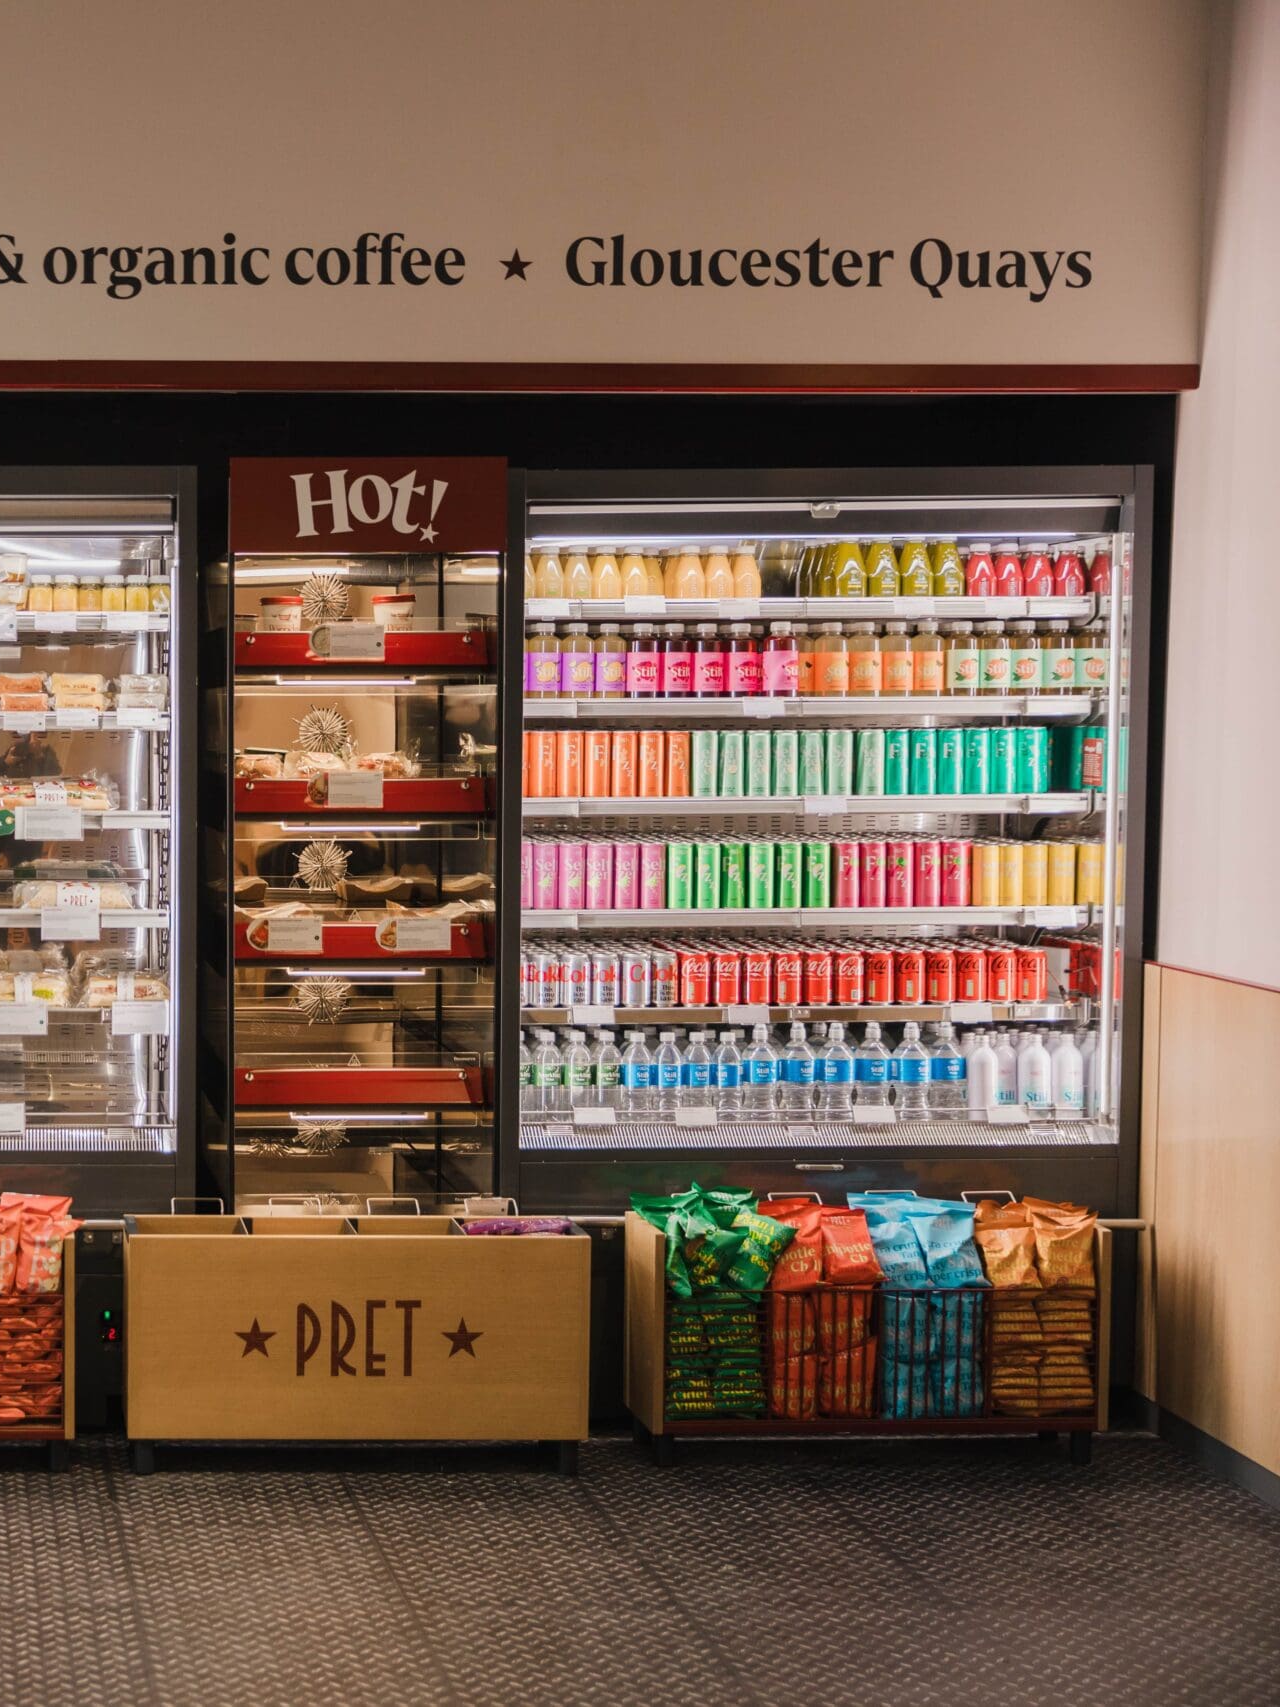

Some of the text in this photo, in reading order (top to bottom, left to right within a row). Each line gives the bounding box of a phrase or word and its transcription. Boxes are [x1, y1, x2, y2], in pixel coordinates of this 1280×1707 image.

[42, 232, 270, 300] organic
[284, 232, 466, 286] coffee
[565, 233, 895, 288] Gloucester
[909, 238, 1092, 303] Quays
[289, 469, 449, 544] Hot!
[634, 665, 657, 678] Still
[70, 895, 87, 906] PRET
[296, 1299, 422, 1377] PRET
